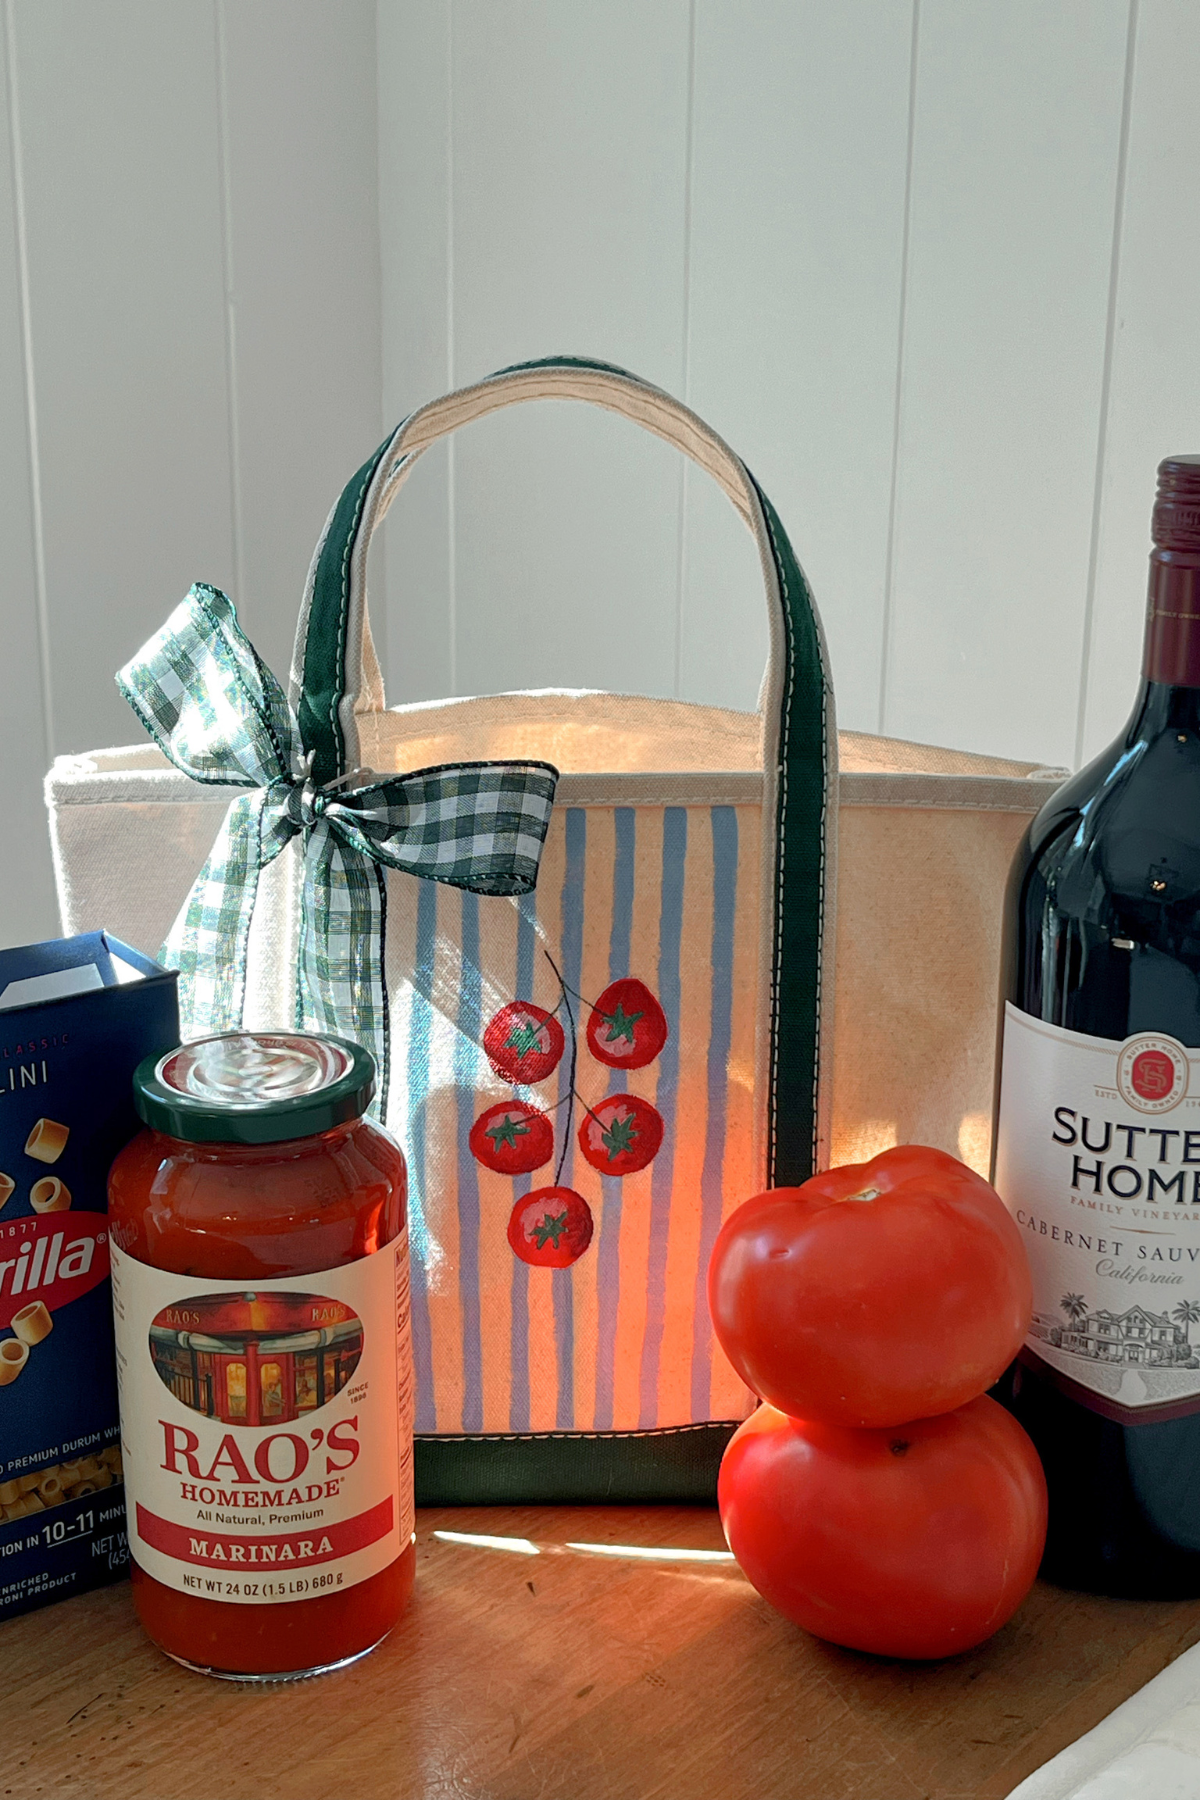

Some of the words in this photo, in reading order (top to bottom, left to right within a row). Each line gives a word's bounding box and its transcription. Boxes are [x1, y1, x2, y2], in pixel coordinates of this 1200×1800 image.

[1126, 1042, 1157, 1060] SUTTER
[1161, 1045, 1181, 1064] HOME
[0, 1060, 48, 1094] INI
[1125, 1085, 1149, 1107] FAMILY
[1070, 1196, 1124, 1215] FAMILY
[0, 1222, 37, 1239] 1877
[1016, 1209, 1124, 1256] CABERNET
[1095, 1258, 1184, 1284] California
[166, 1309, 200, 1325] RAO'S
[311, 1304, 346, 1322] RAO'S
[347, 1381, 368, 1397] SINCE
[8, 1446, 59, 1472] PREMIUM
[62, 1432, 101, 1454] DURUM
[158, 1415, 361, 1484] RAO'S
[196, 1509, 212, 1521] All
[215, 1512, 266, 1526] Natural,
[269, 1508, 324, 1525] Premium
[26, 1534, 39, 1549] IN
[42, 1510, 94, 1544] 10-11
[92, 1535, 115, 1557] NET
[189, 1536, 334, 1563] MARINARA
[0, 1572, 49, 1597] NRICHED
[27, 1572, 77, 1596] PRODUCT
[183, 1574, 203, 1590] NET
[205, 1579, 222, 1593] WT
[226, 1583, 240, 1595] 24
[243, 1584, 259, 1596] OZ
[262, 1583, 286, 1597] (1.5
[289, 1579, 309, 1595] LB)
[312, 1573, 334, 1589] 680
[336, 1572, 343, 1585] g
